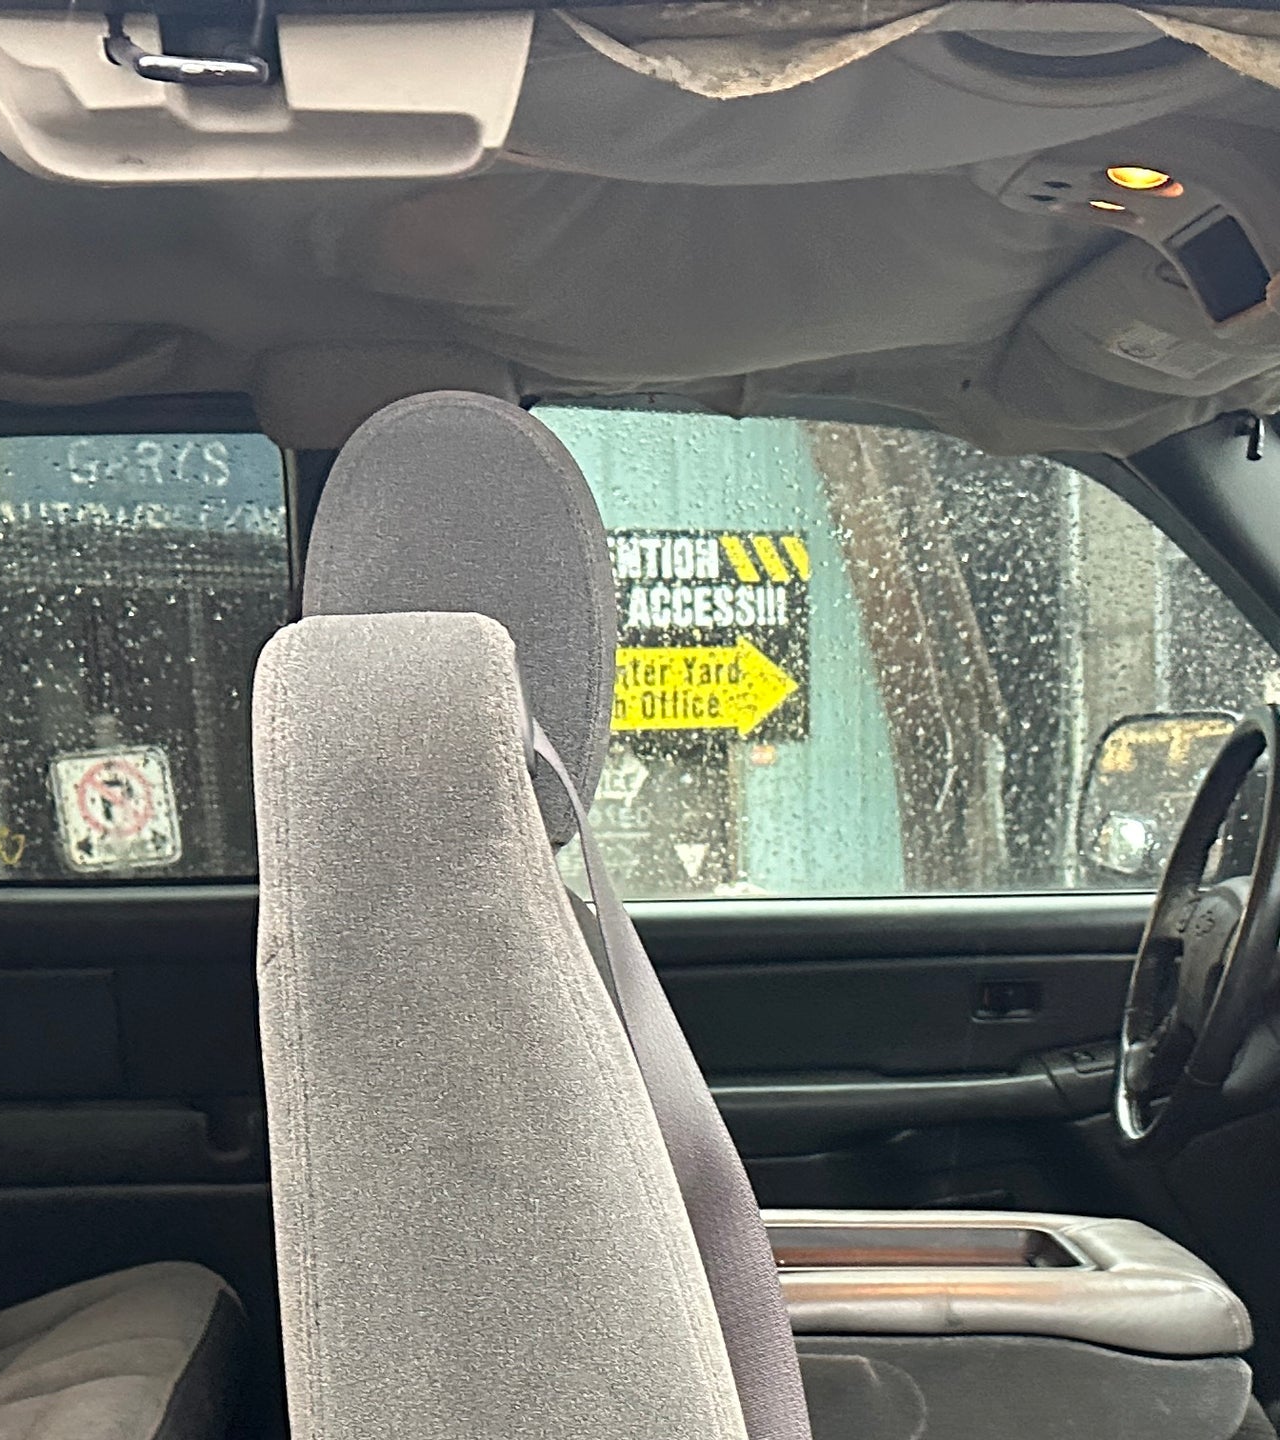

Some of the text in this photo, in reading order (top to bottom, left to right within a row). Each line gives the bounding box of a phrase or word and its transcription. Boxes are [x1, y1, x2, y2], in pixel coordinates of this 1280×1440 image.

[608, 537, 720, 579] NTION
[626, 584, 788, 629] ACCESS!!!
[616, 655, 742, 690] nter Yard
[640, 689, 721, 720] Office
